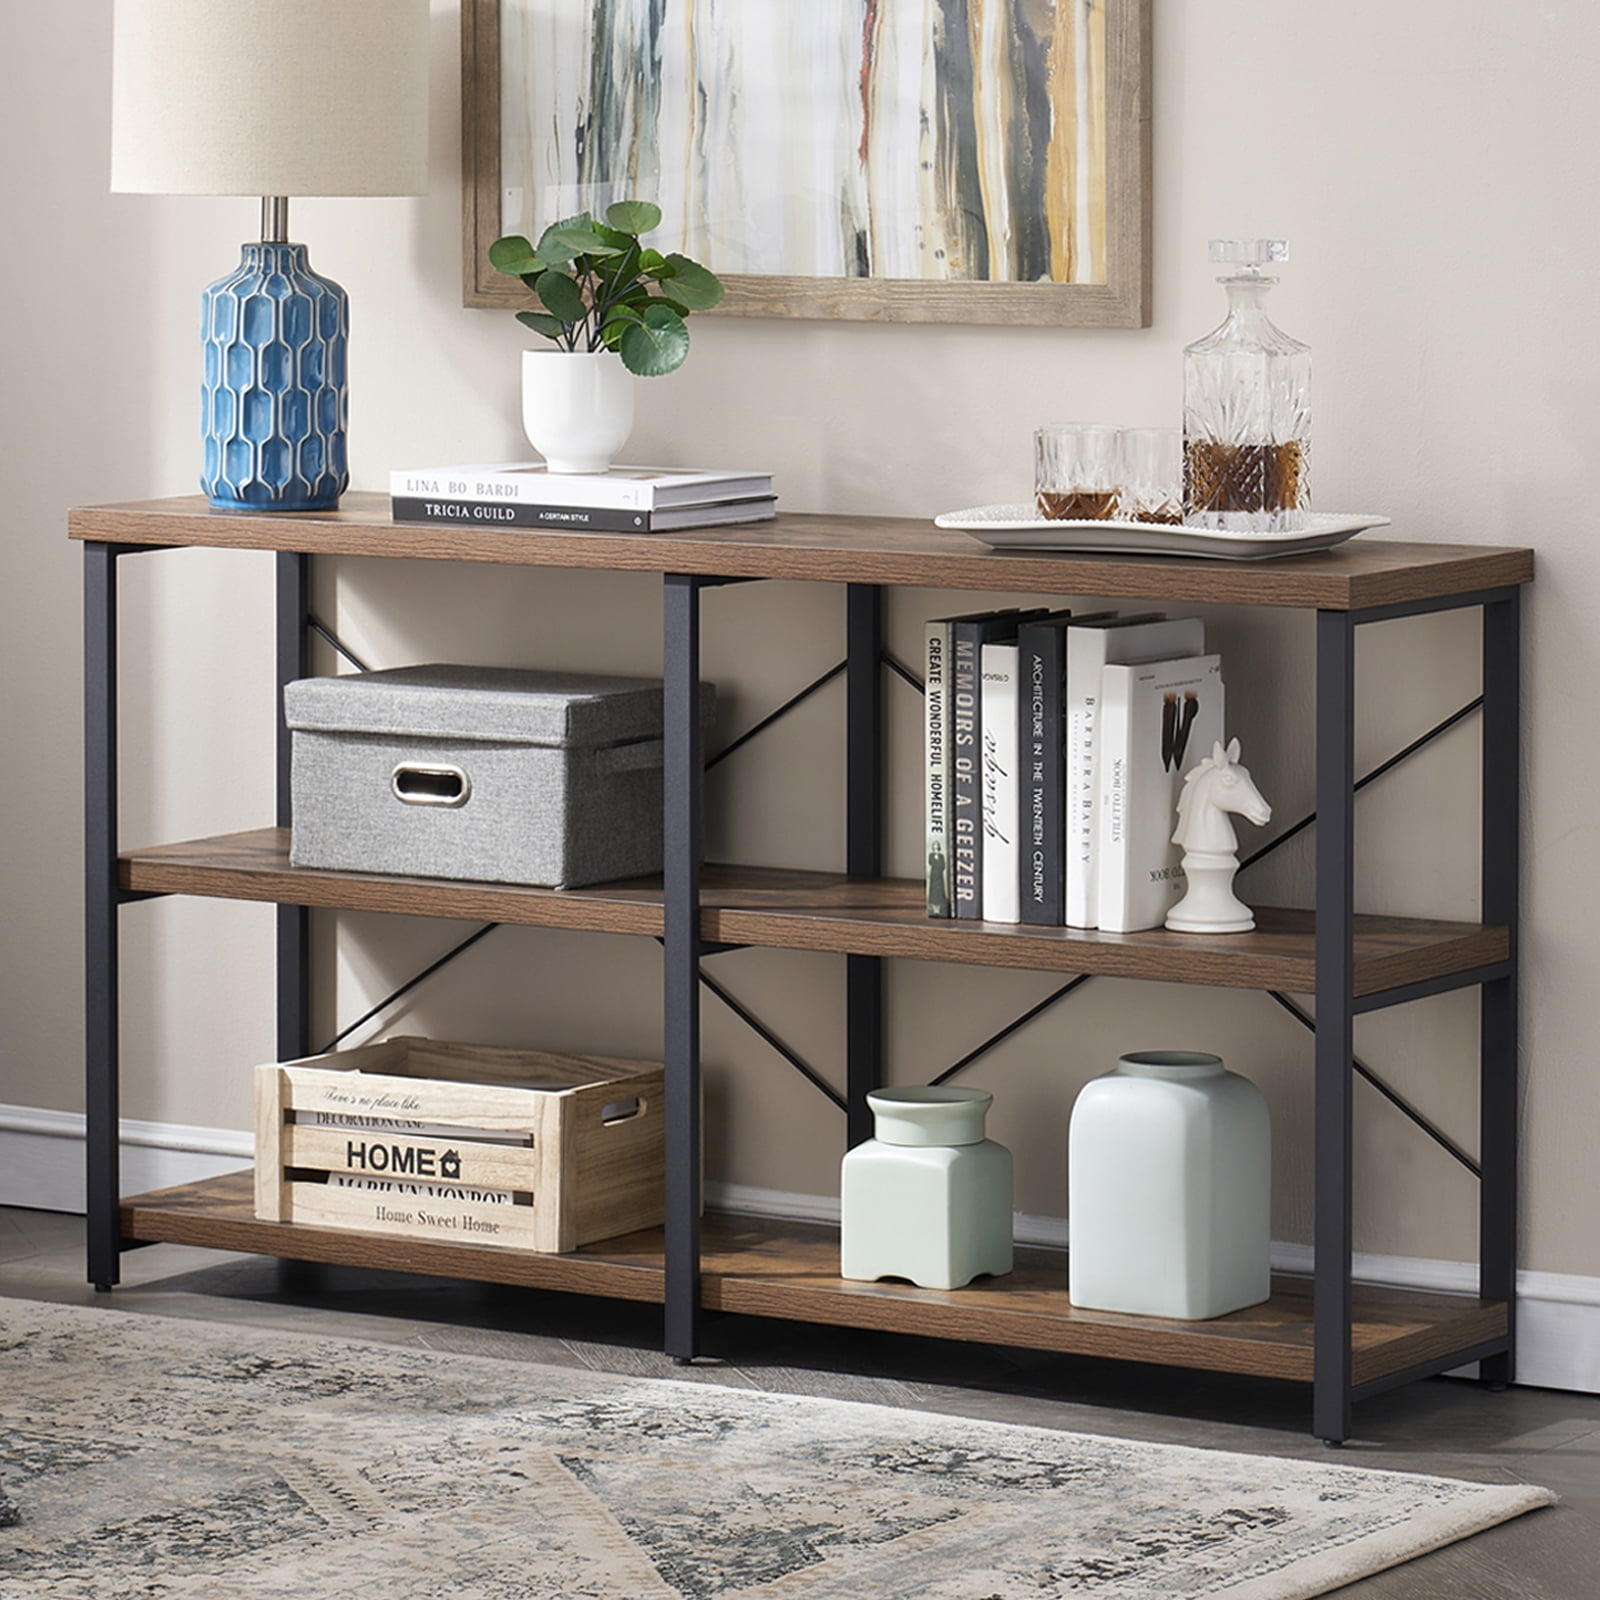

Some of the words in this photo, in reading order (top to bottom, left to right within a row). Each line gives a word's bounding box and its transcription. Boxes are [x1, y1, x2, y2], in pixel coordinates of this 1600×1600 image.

[406, 479, 440, 493] LINA
[448, 481, 467, 494] BO
[476, 483, 519, 497] BARDI
[425, 504, 470, 518] TRICIA
[473, 507, 516, 520] GUILD
[929, 637, 942, 684] CREATE
[956, 640, 974, 746] MEMOIRS
[1032, 654, 1043, 738] ARCHITECTURE
[929, 690, 943, 767] WONDERFUL
[1033, 742, 1043, 756] IN
[956, 757, 973, 785] OF
[1033, 761, 1043, 782] THE
[1112, 759, 1121, 789] BOOK
[930, 773, 944, 834] HOMELIFE
[956, 793, 972, 806] A
[1032, 788, 1043, 846] TWENTIETH
[956, 818, 974, 901] GEEZER
[1033, 850, 1044, 904] CENTURY
[347, 1141, 436, 1177] HOME
[376, 1206, 414, 1223] Home
[418, 1210, 458, 1229] Sweet
[462, 1215, 501, 1234] Home
